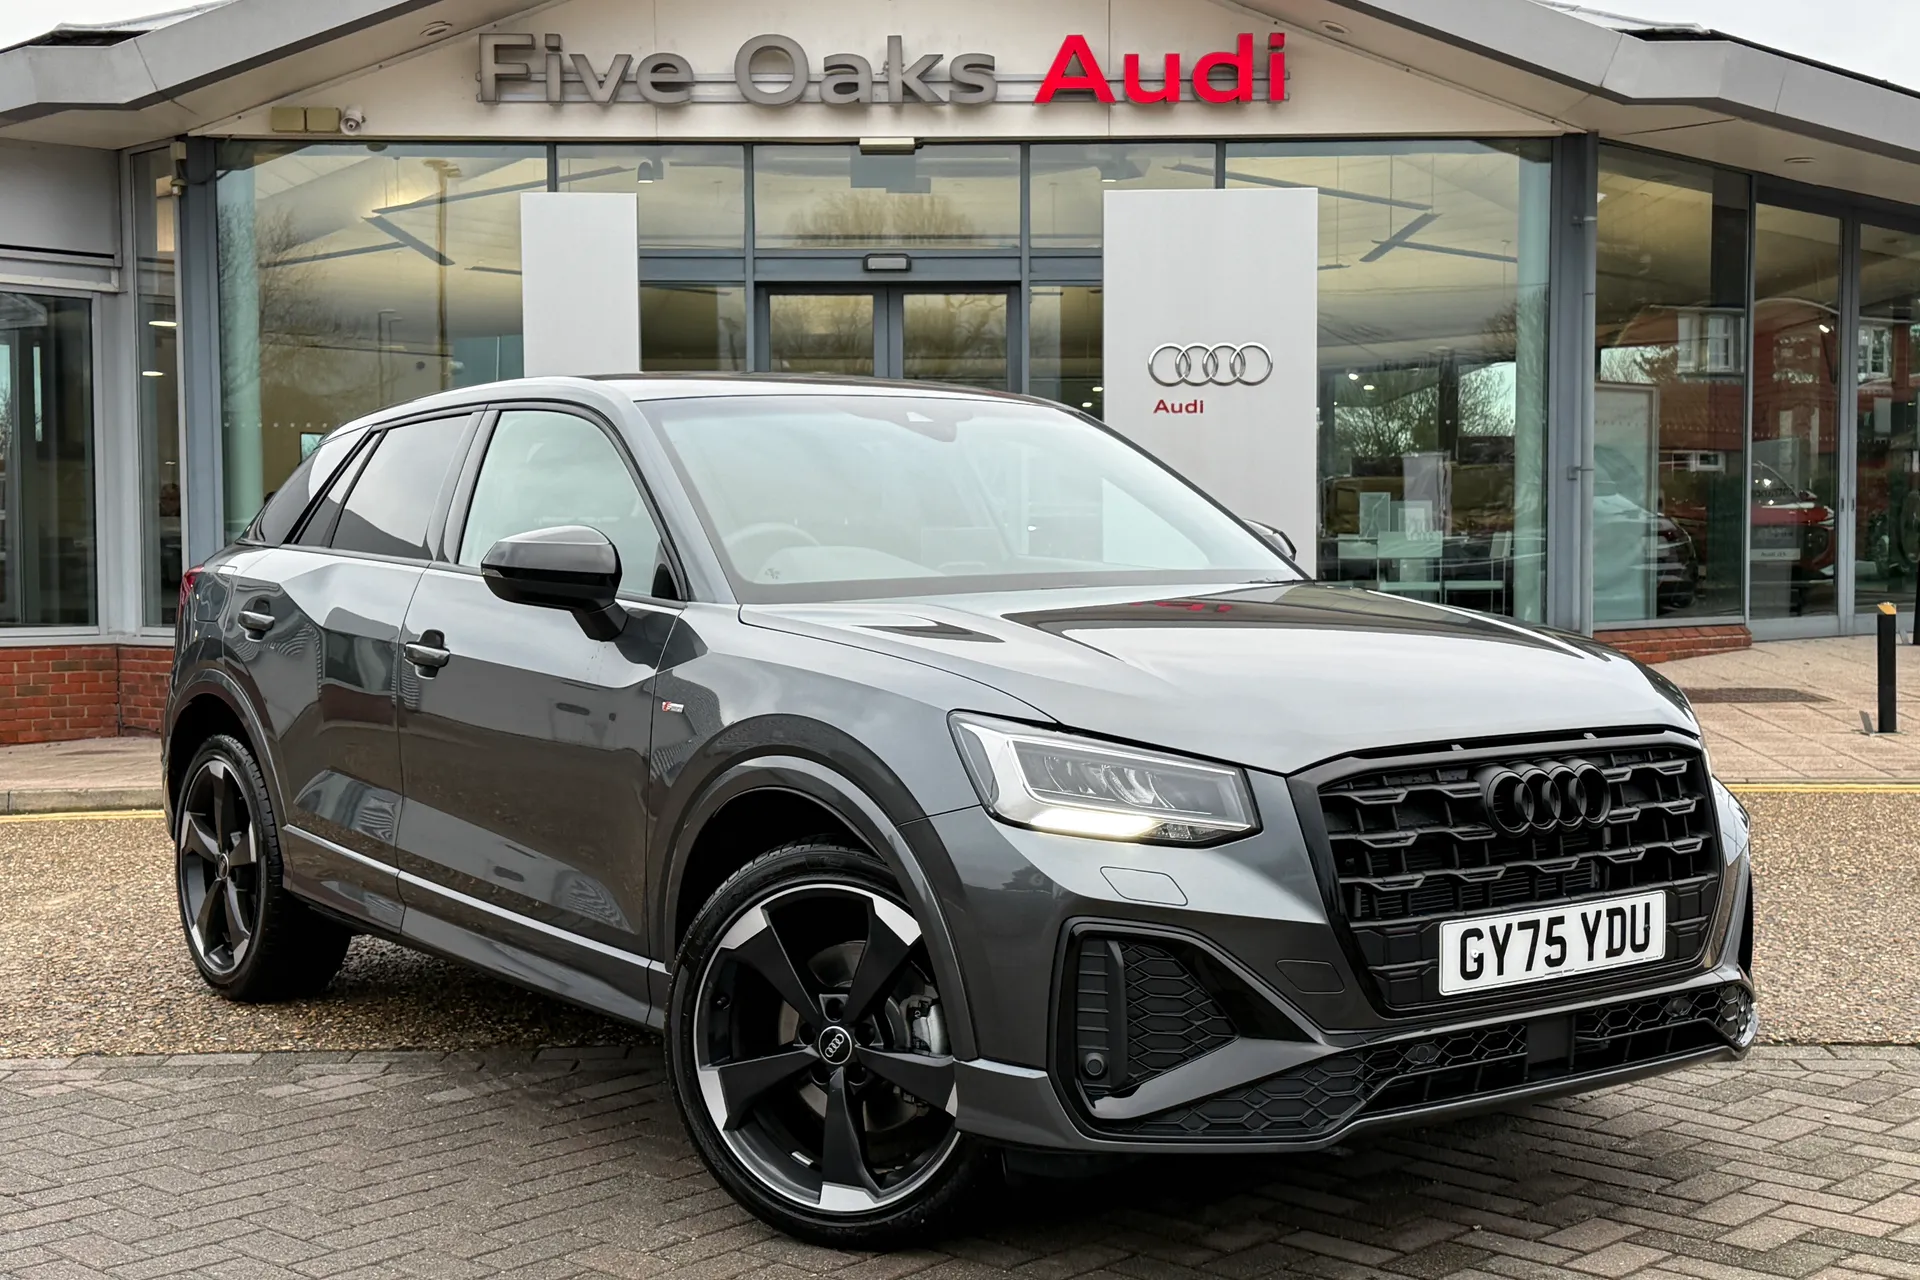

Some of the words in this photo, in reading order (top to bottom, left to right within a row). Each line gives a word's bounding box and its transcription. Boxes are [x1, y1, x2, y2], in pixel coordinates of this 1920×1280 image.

[478, 33, 695, 106] Five
[734, 33, 998, 106] Oaks
[1032, 32, 1286, 105] Audi
[1153, 399, 1204, 414] Audi
[1460, 915, 1567, 981] GY75
[1580, 901, 1651, 962] YDU
